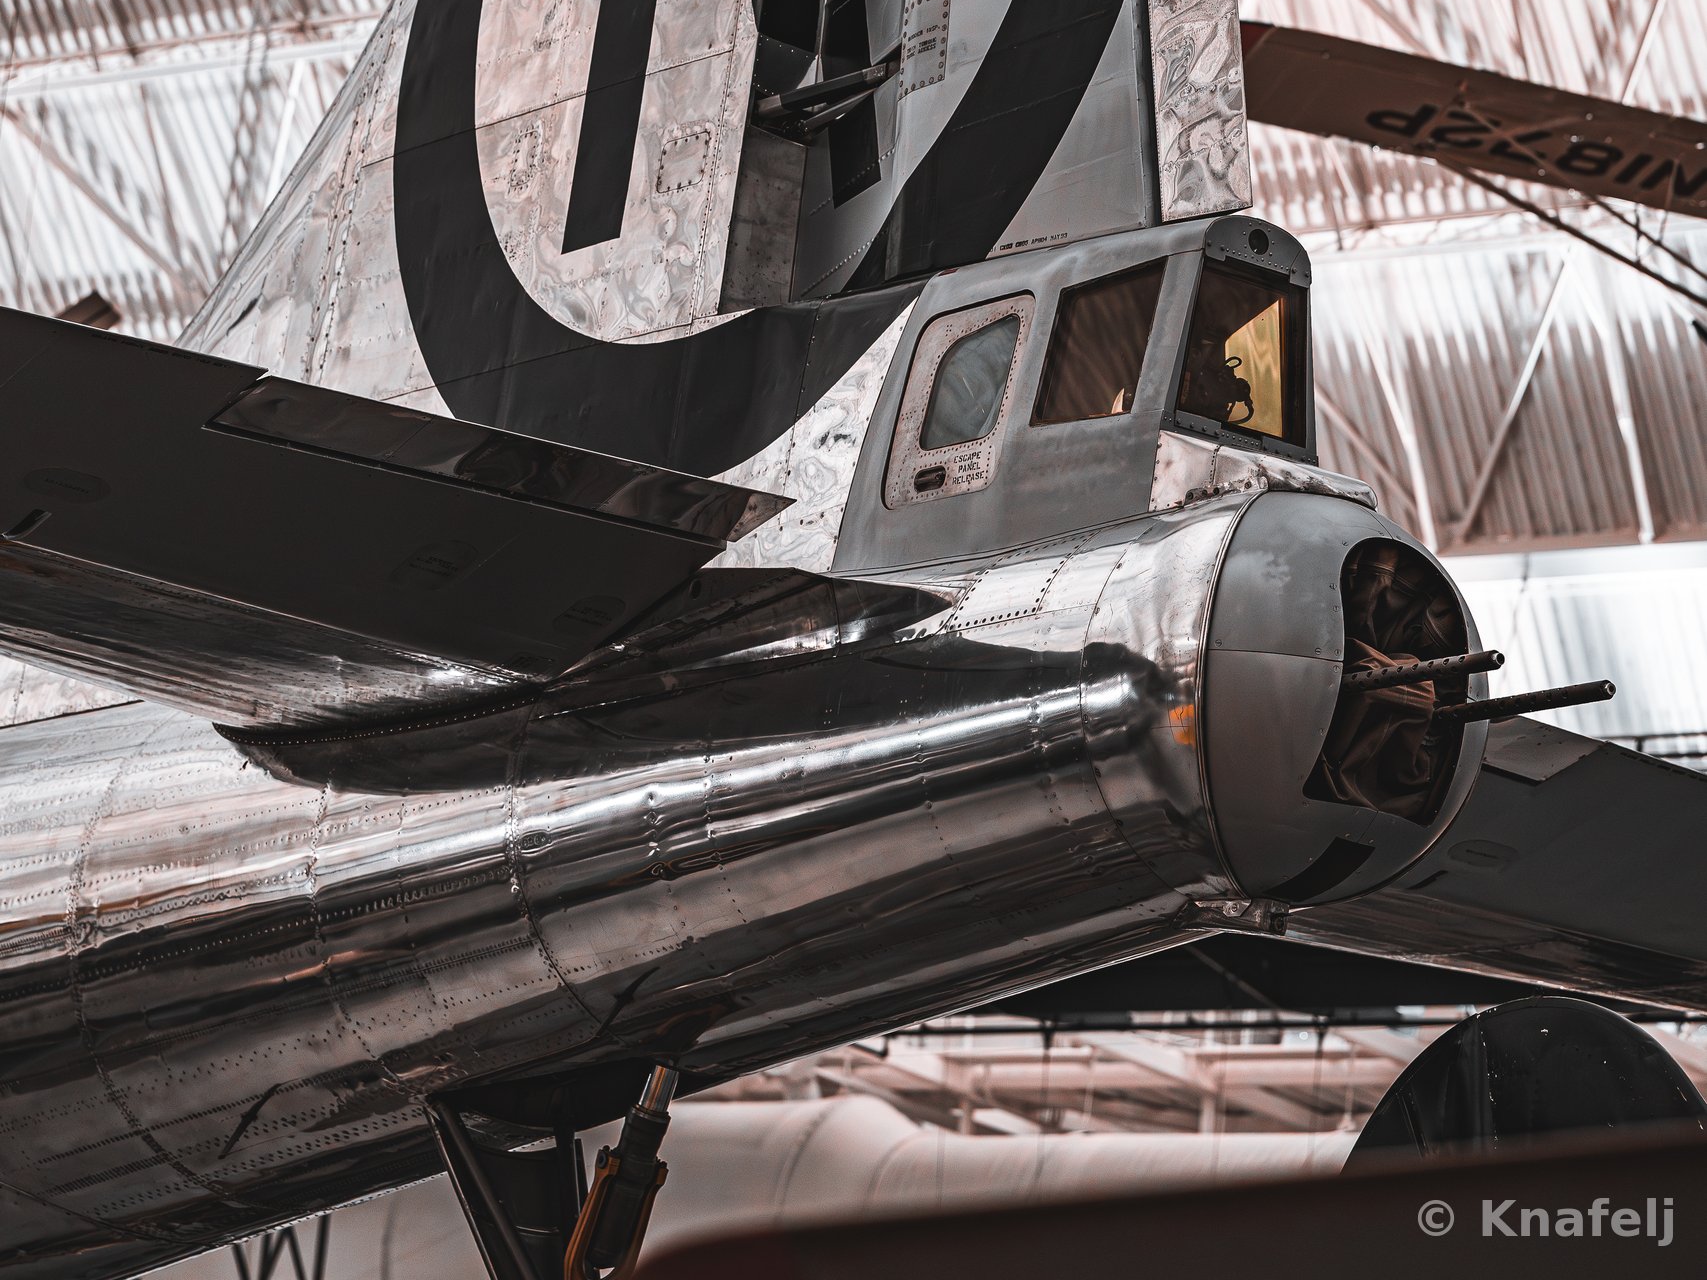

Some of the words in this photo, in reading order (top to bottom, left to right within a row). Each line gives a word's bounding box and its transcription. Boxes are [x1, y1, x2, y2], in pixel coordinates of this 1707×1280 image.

[953, 451, 982, 464] ESCAPE
[958, 462, 981, 473] PANEL
[952, 470, 985, 485] RELEASE
